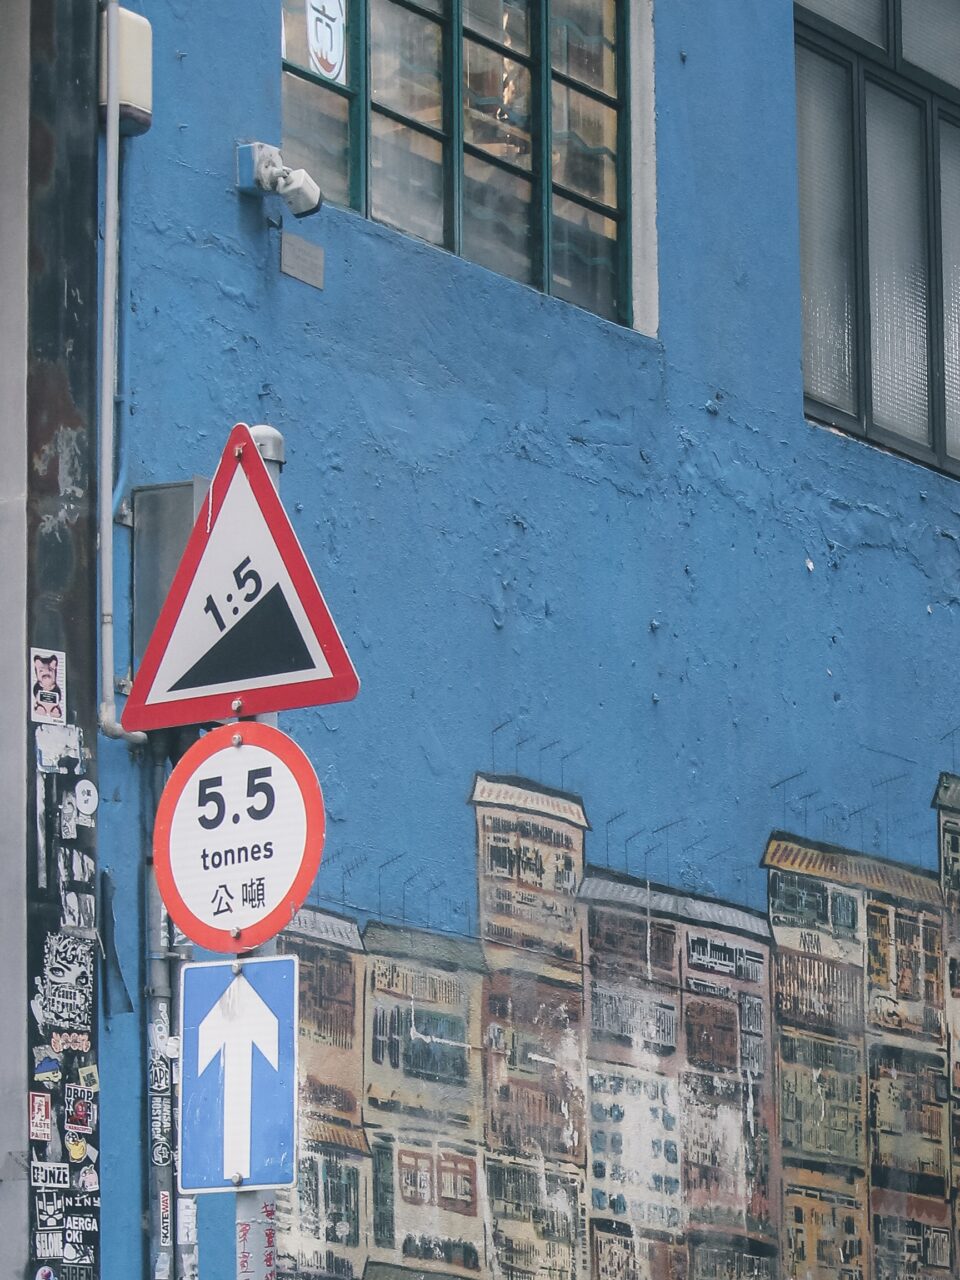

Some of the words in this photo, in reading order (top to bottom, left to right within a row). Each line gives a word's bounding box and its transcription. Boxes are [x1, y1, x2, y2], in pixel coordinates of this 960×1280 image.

[203, 556, 263, 633] 1:5
[197, 766, 276, 830] 5.5
[201, 840, 274, 871] tonnes
[211, 877, 267, 917] 公噸
[66, 1086, 93, 1101] DROP
[31, 1121, 50, 1129] TASTE
[66, 1216, 99, 1232] AERGA
[161, 1192, 170, 1245] SKATEWAY
